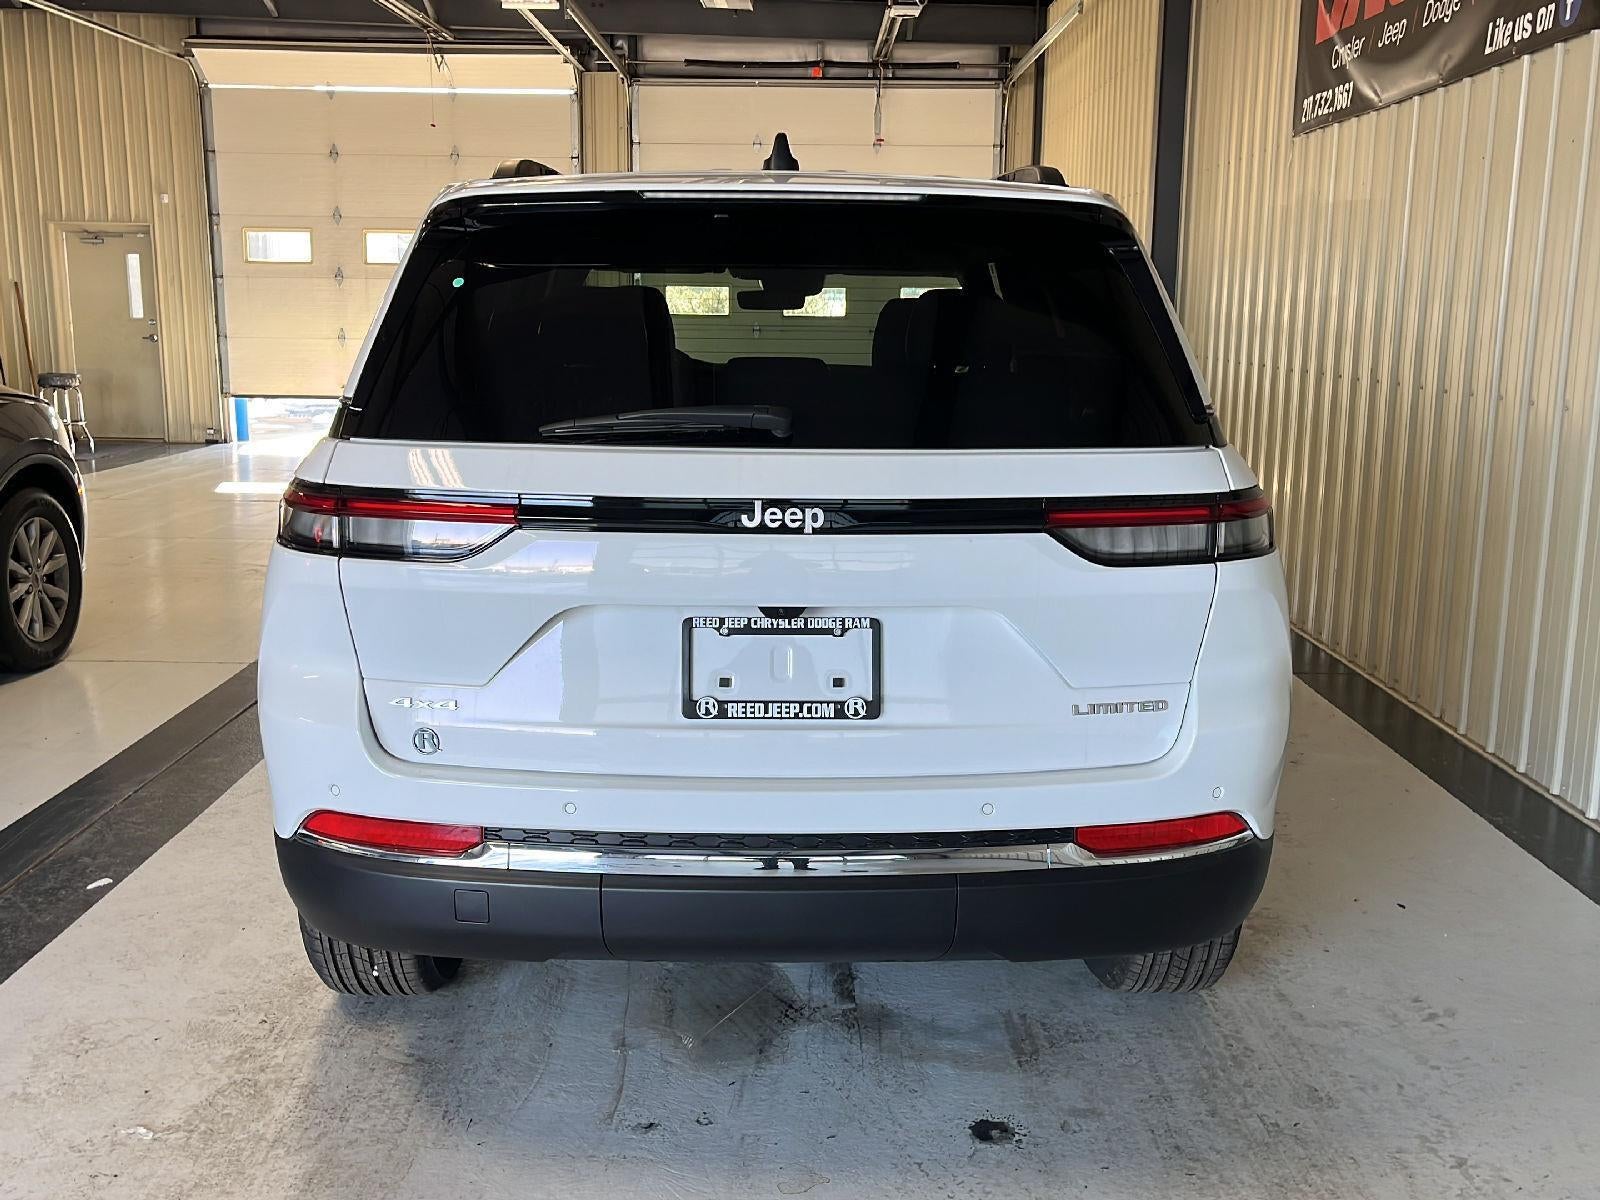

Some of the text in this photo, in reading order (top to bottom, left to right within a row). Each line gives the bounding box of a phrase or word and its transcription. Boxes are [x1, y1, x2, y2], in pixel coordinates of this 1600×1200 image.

[1378, 19, 1407, 48] Jeep
[1484, 17, 1513, 55] Like
[1514, 12, 1532, 42] us
[1536, 3, 1556, 33] on
[741, 500, 824, 534] Jeep
[692, 617, 870, 629] REED JEEP CHRYSLER DODGE RAM
[388, 697, 460, 711] 4x4
[727, 703, 835, 718] REEDJEEP.COM
[1072, 700, 1169, 716] LIMITED
